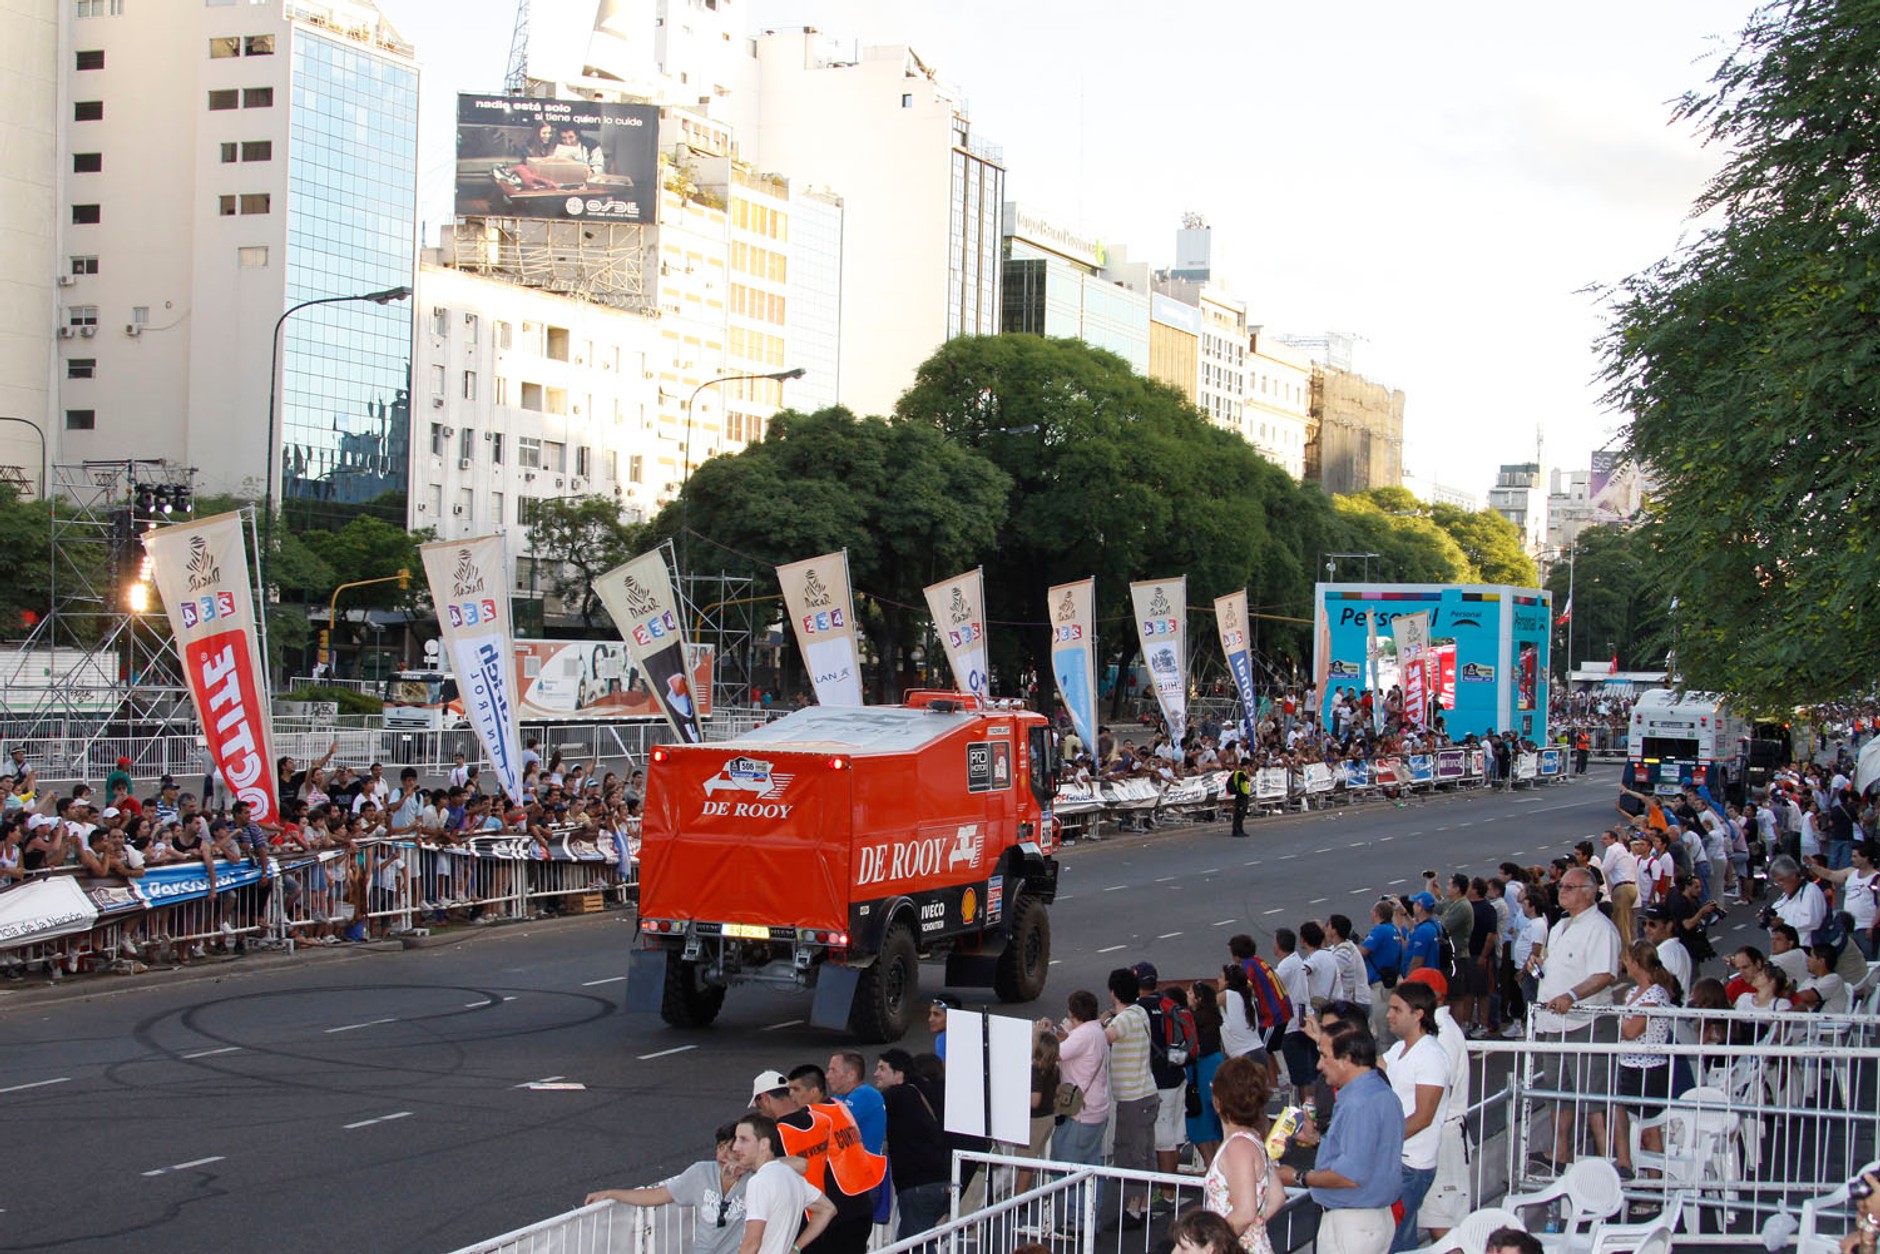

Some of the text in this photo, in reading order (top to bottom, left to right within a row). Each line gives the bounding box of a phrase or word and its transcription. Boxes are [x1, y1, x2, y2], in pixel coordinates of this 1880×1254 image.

[475, 100, 571, 113] nadie está solo
[534, 112, 643, 127] si tiene quien lo cuide
[586, 200, 640, 214] OSDE
[629, 597, 661, 619] DAKAR
[804, 593, 831, 608] DAKAR
[1340, 607, 1439, 627] Pesl
[815, 671, 838, 684] LAN
[971, 751, 988, 764] PRO
[741, 762, 755, 771] 506
[702, 801, 793, 820] DE ROOY
[857, 837, 948, 886] DE ROOY
[921, 902, 945, 920] IVECO
[47, 911, 83, 927] Nación
